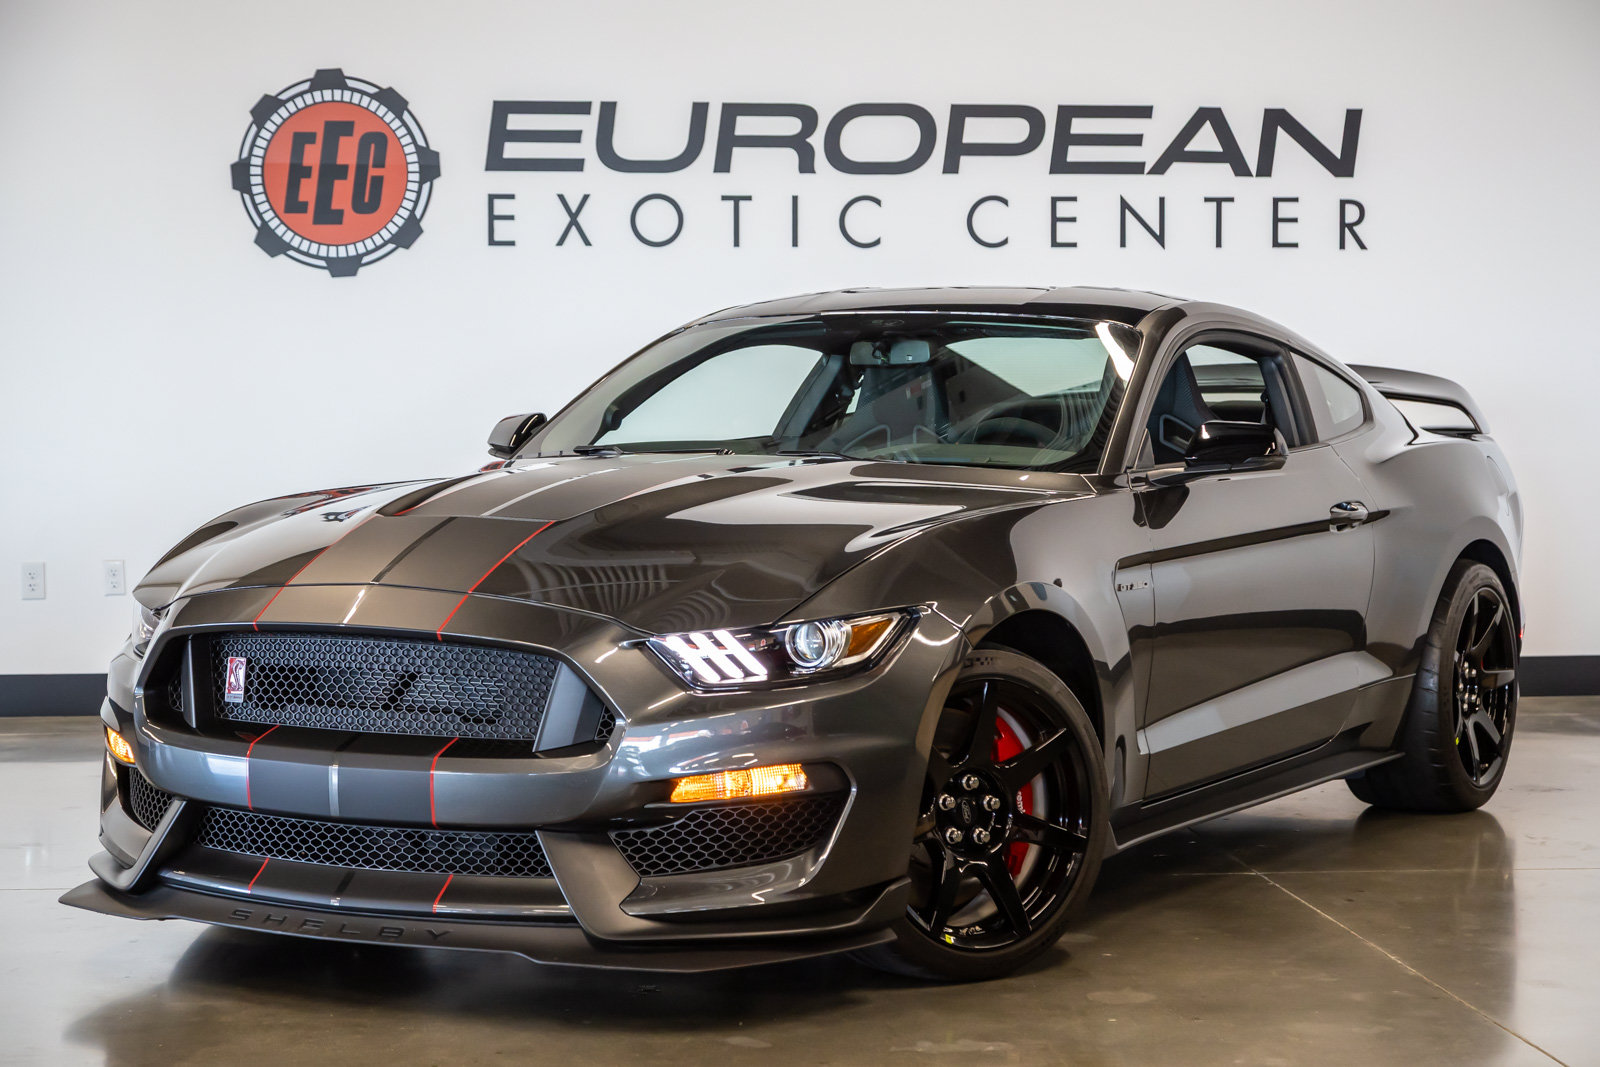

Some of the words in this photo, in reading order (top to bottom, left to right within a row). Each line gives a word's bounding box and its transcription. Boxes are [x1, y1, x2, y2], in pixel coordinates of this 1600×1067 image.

[485, 100, 1363, 178] EUROPEAN
[284, 121, 388, 226] EEC
[488, 193, 881, 249] EXOTIC
[966, 195, 1368, 250] CENTER
[228, 907, 453, 941] SHELBY
